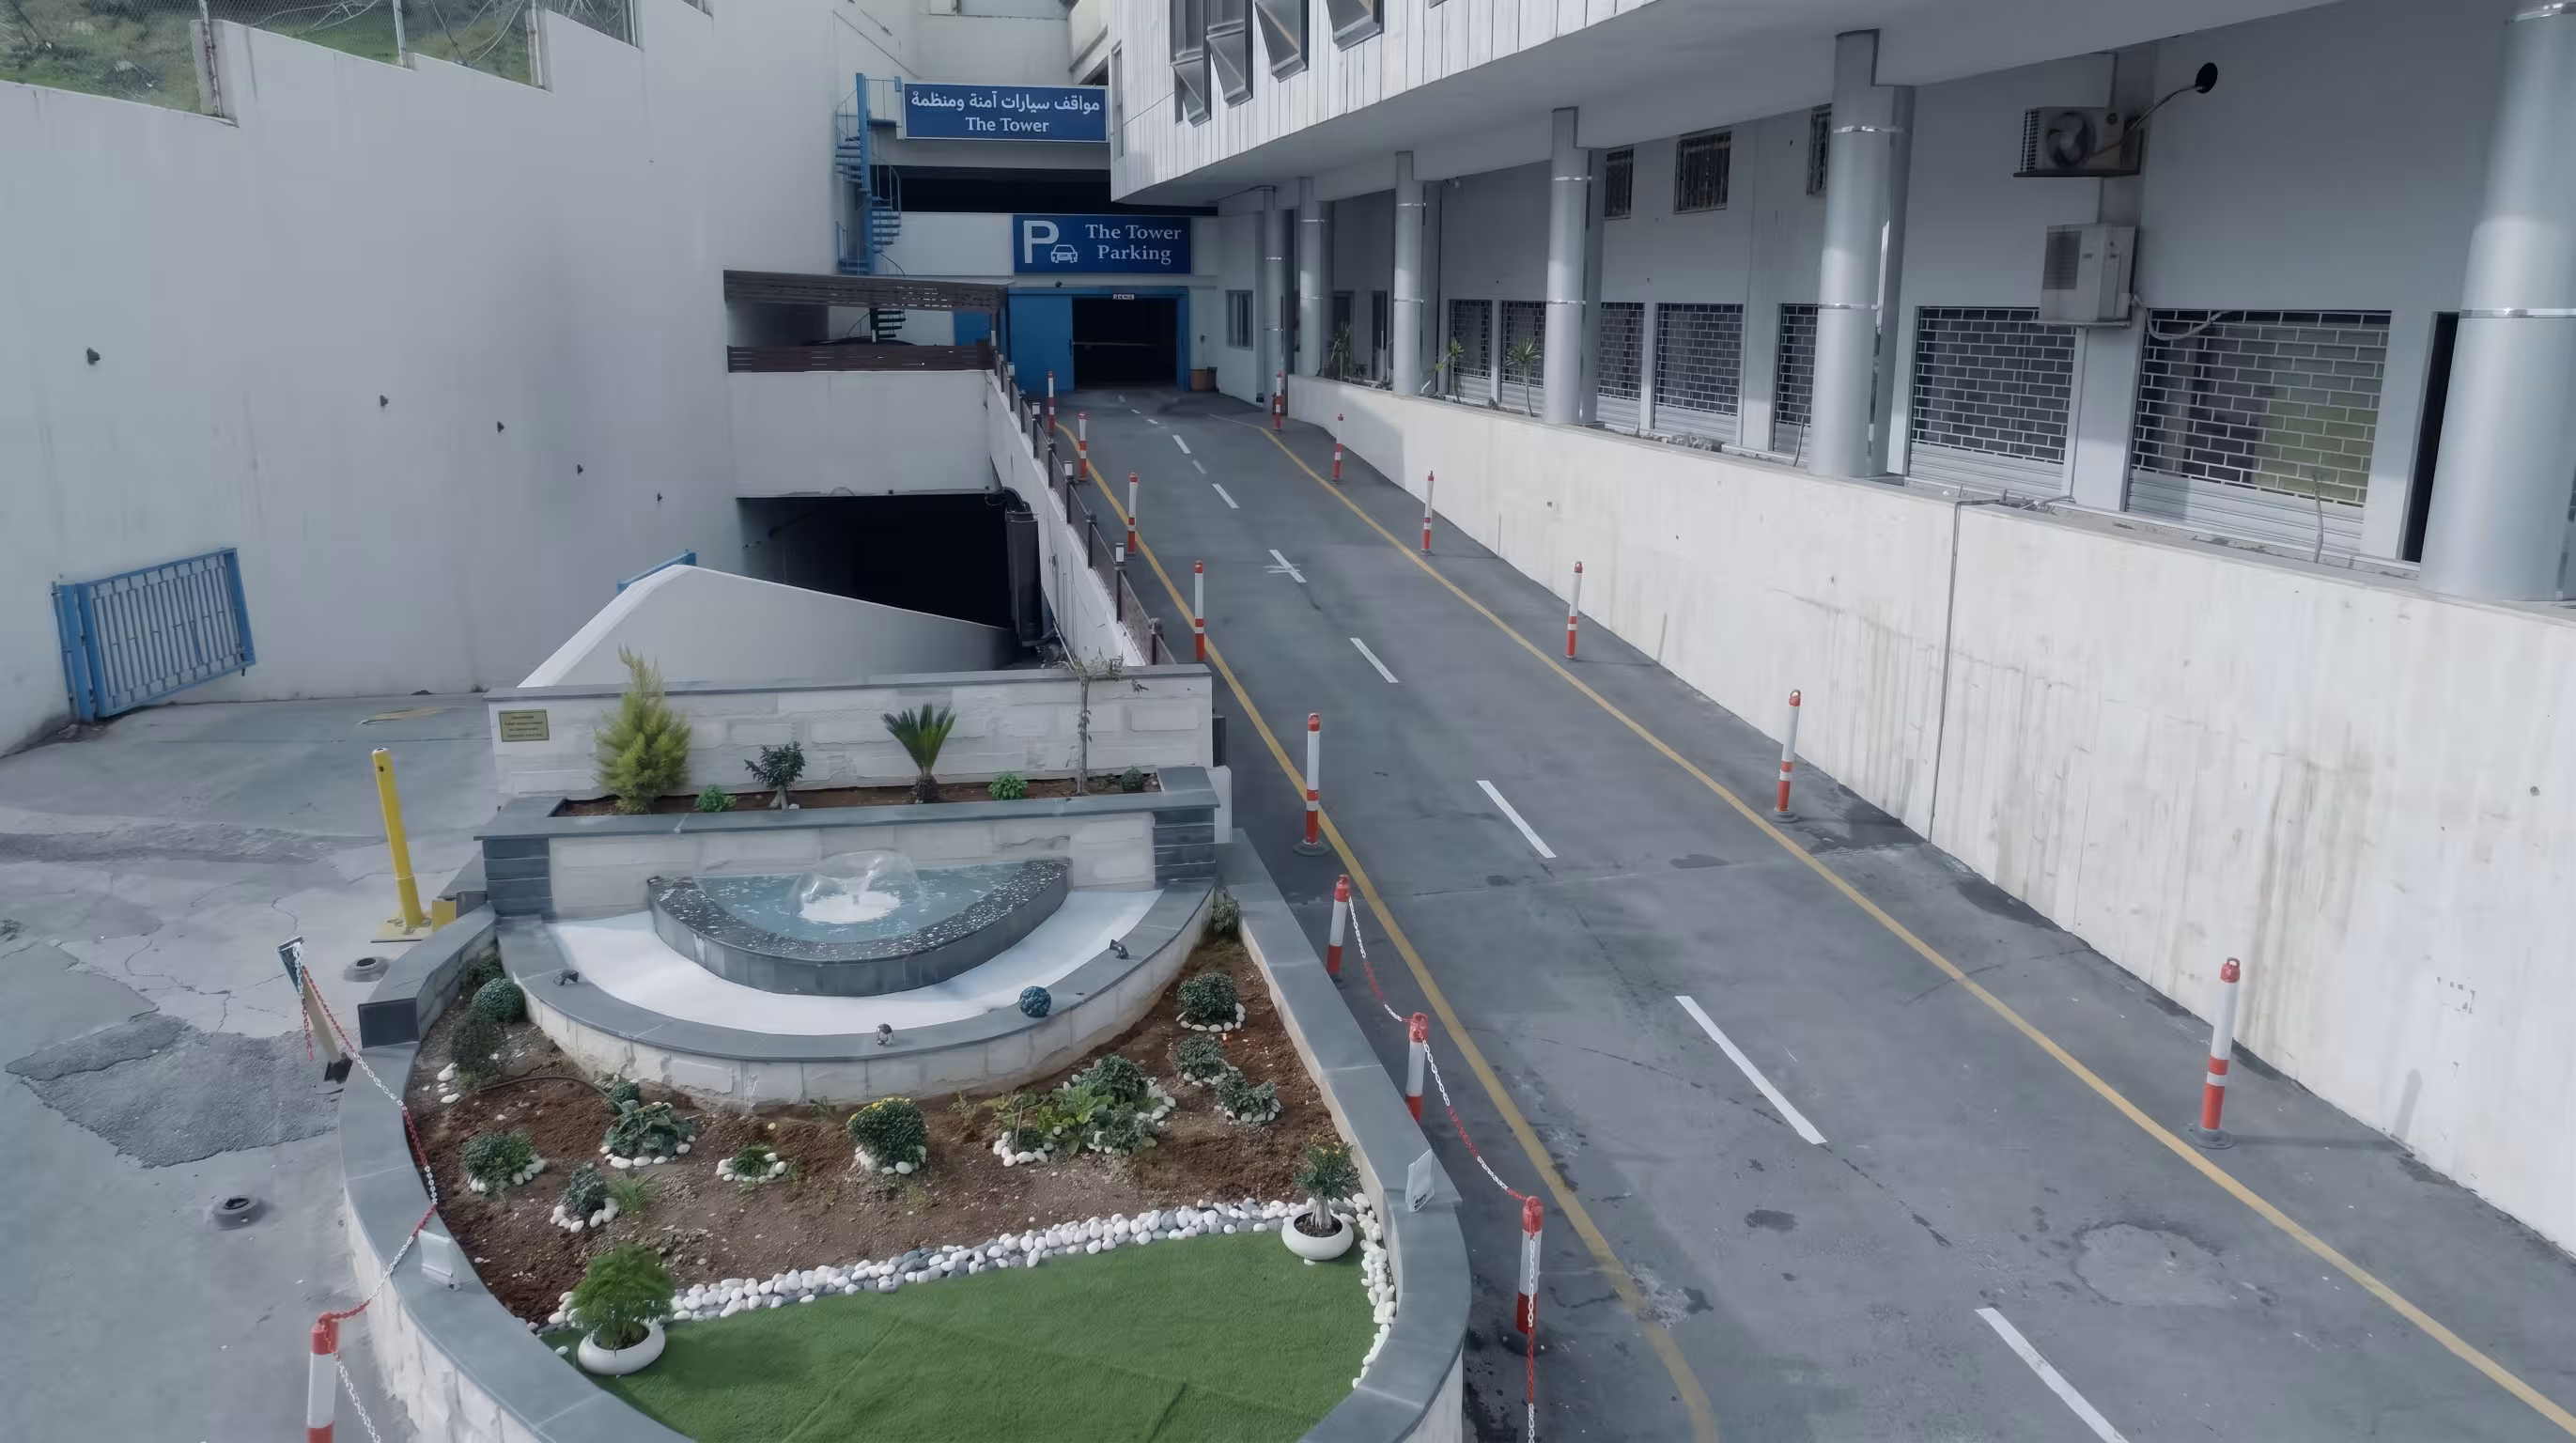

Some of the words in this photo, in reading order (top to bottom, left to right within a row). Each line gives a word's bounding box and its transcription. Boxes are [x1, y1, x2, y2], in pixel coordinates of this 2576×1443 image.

[970, 90, 998, 109] آمنة
[1001, 93, 1050, 113] سيارات
[1054, 95, 1100, 115] مواقف
[965, 116, 996, 132] The
[1000, 117, 1049, 132] Tower
[1023, 220, 1060, 264] P
[1085, 224, 1121, 239] The
[1125, 225, 1182, 240] Tower
[1097, 244, 1172, 265] Parking
